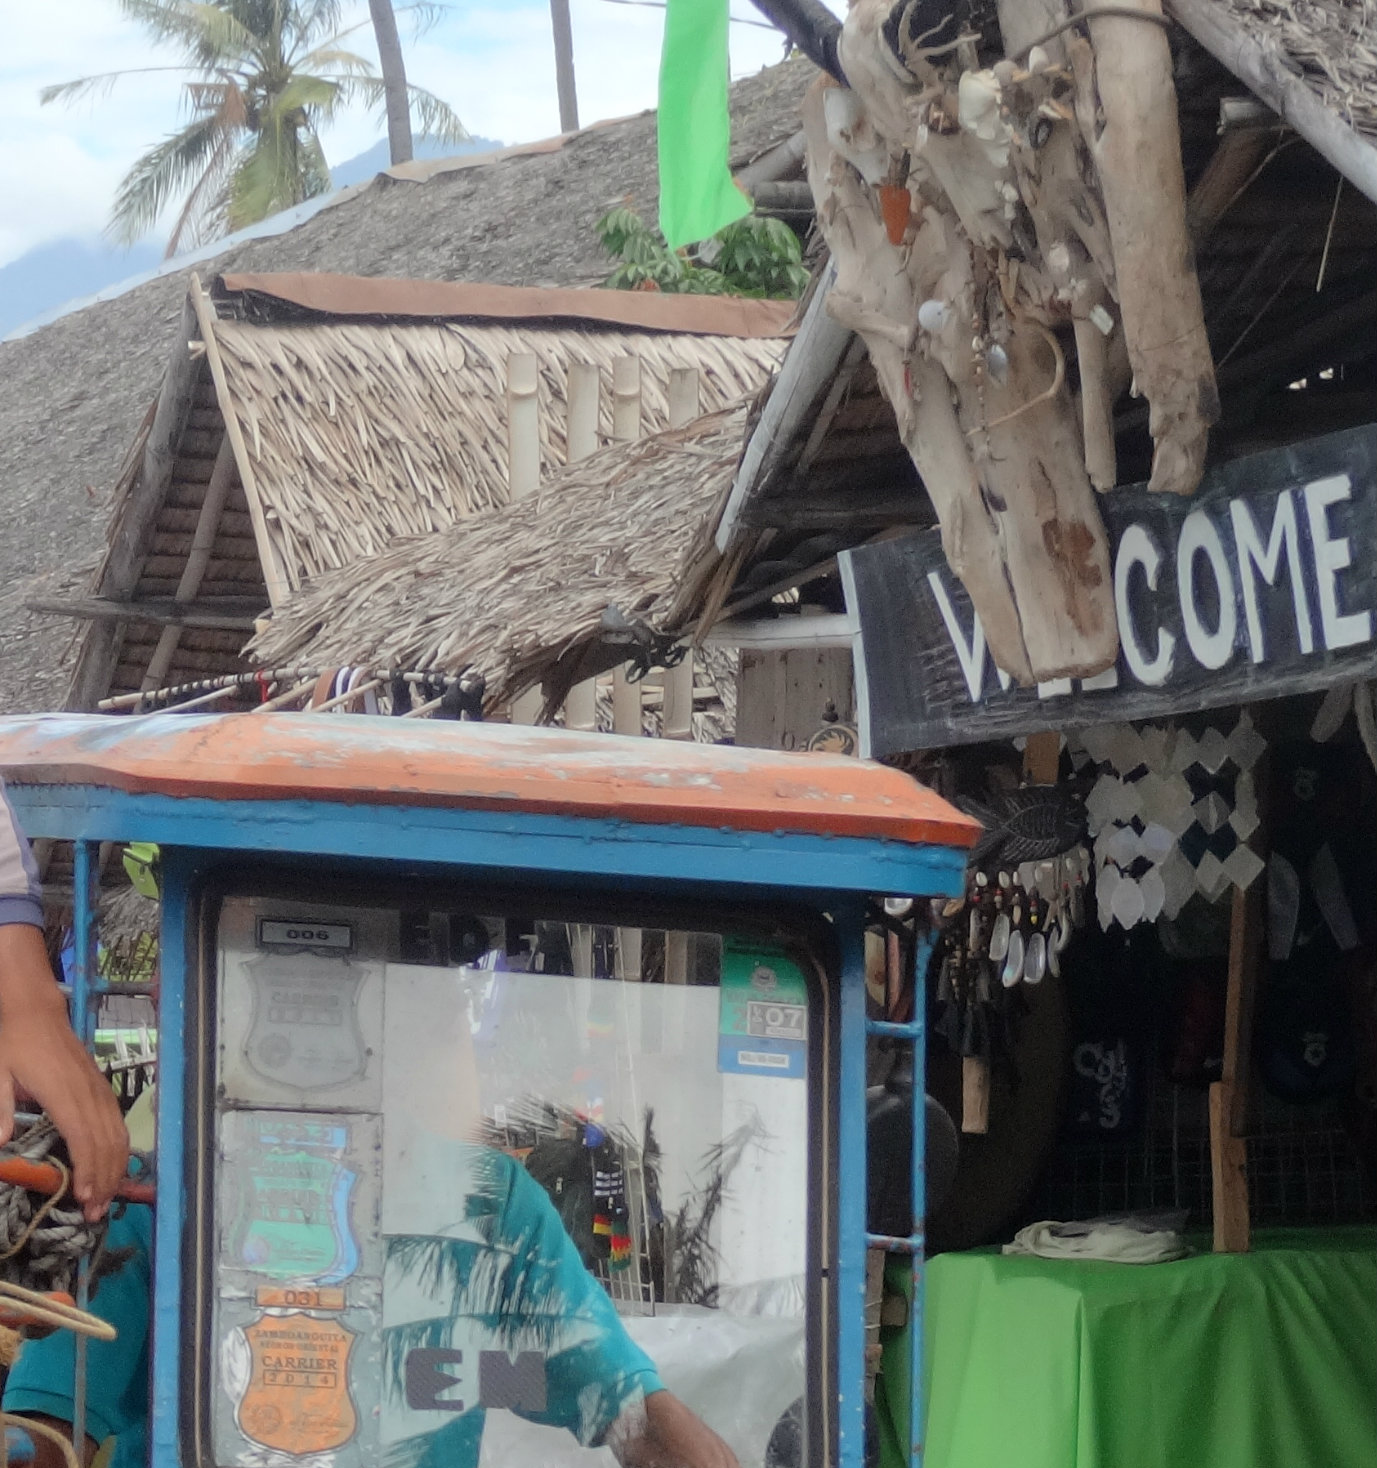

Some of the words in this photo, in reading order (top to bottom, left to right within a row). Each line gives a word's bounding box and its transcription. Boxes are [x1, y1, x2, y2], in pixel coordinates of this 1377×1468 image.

[766, 1007, 802, 1027] 07
[285, 1291, 322, 1306] 031
[261, 1355, 338, 1371] CARRIER
